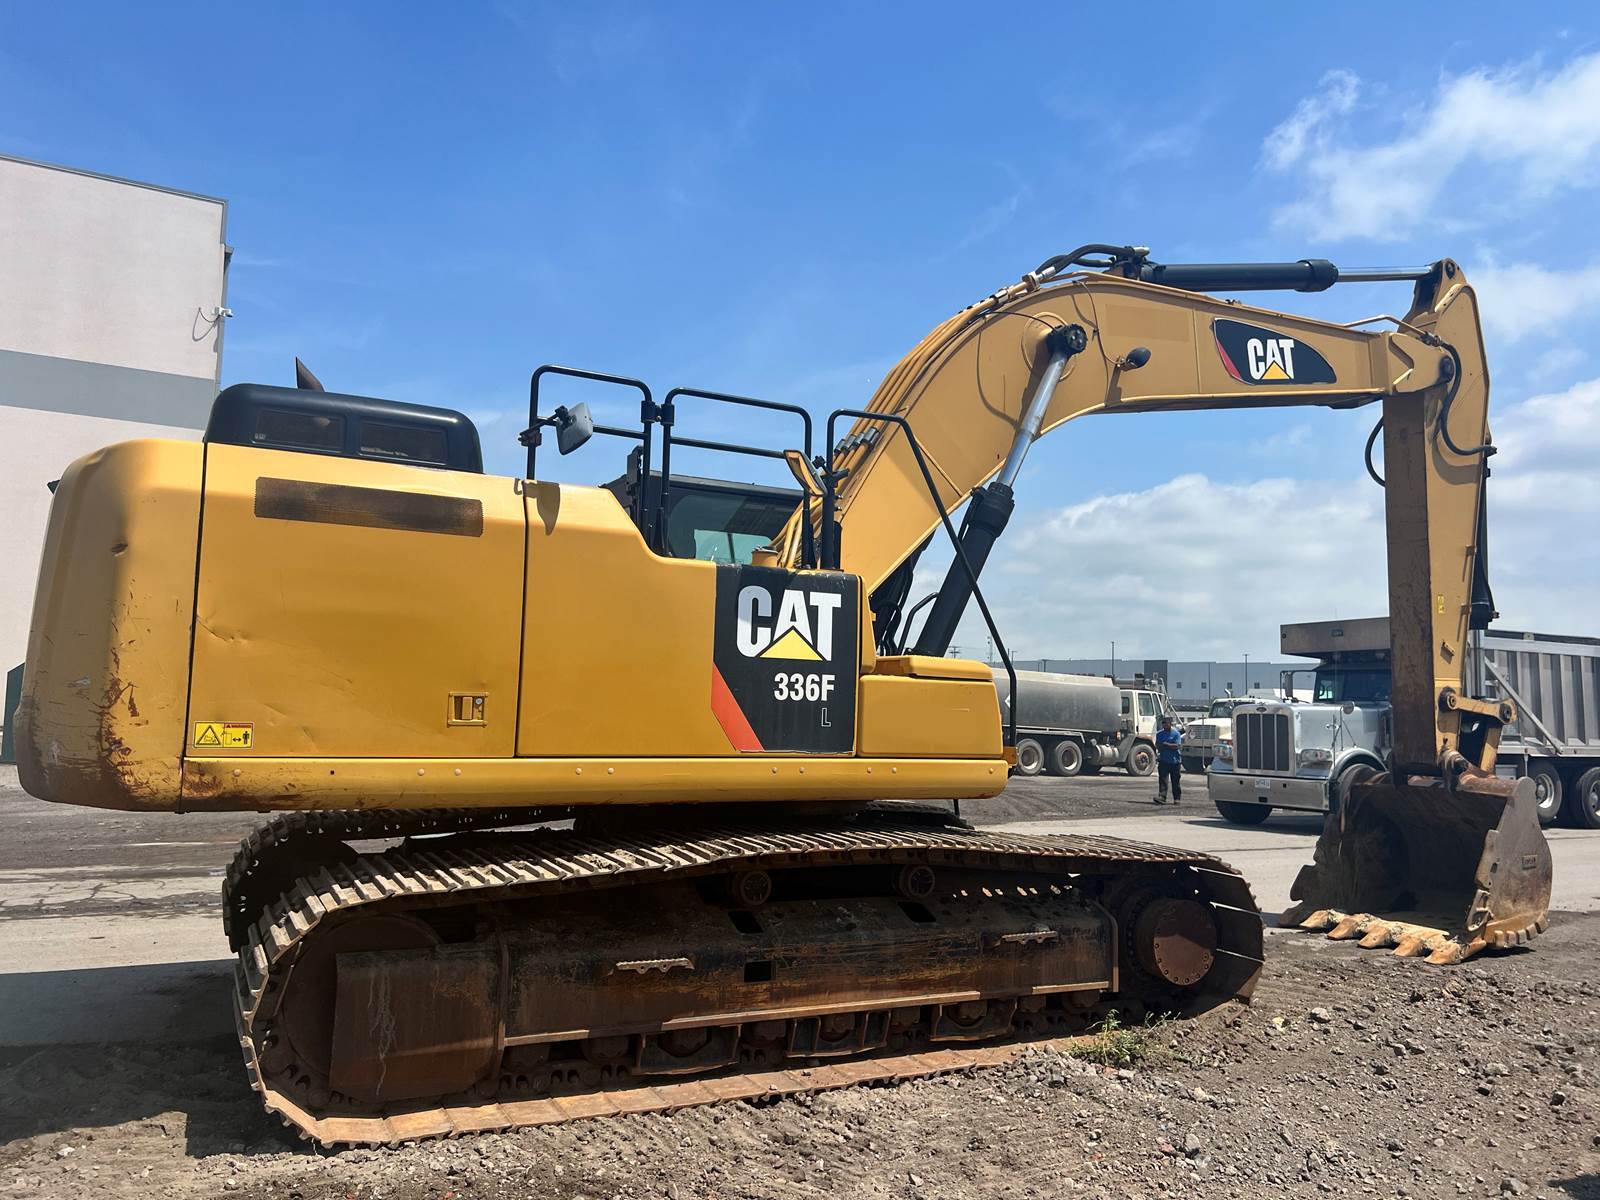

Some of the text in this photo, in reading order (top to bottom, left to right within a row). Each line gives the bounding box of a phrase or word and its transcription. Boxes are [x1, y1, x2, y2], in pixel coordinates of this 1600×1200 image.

[1247, 338, 1294, 380] CAT
[736, 585, 842, 662] CAT
[774, 672, 836, 702] 336F
[820, 707, 832, 727] L
